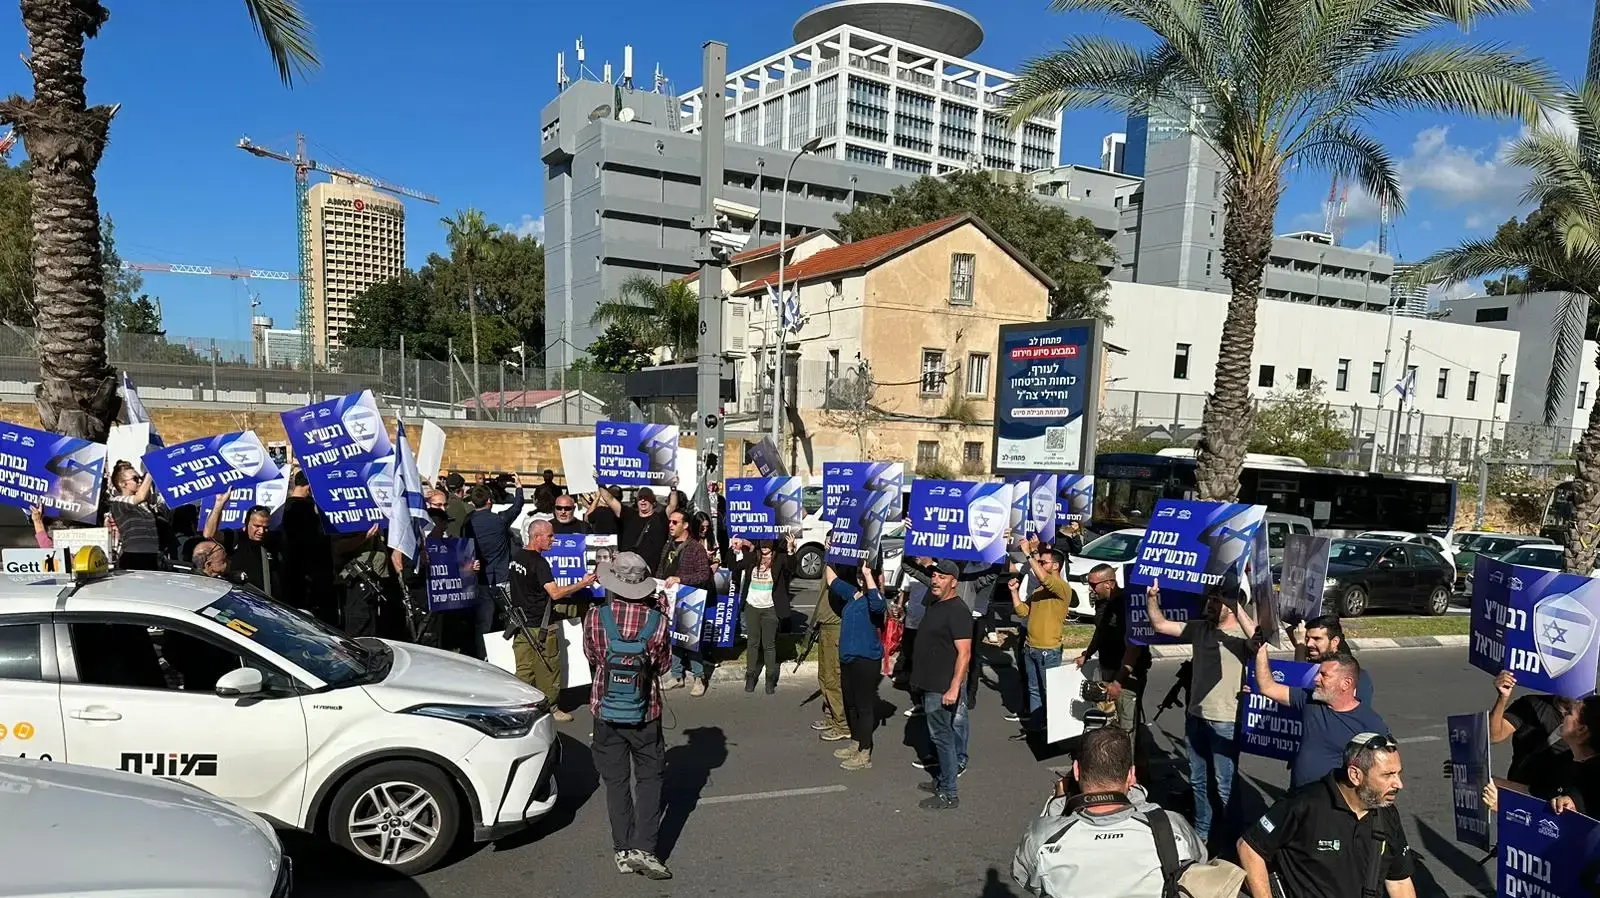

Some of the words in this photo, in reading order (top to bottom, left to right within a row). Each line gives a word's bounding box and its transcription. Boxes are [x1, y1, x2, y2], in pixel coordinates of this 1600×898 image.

[326, 198, 353, 207] AMOT
[1029, 336, 1039, 346] לב
[1040, 336, 1062, 346] פתחון
[1012, 349, 1032, 358] חירום
[1033, 348, 1050, 357] סיוע
[1051, 347, 1076, 356] במבצע
[1028, 362, 1059, 377] לעורף,
[1011, 377, 1047, 389] הביטחון
[1048, 376, 1076, 386] כוחות
[1016, 389, 1039, 400] צה"ל
[1041, 389, 1068, 400] וחיילי
[304, 423, 343, 445] רבש"צ
[302, 447, 340, 468] ישראל
[341, 443, 362, 459] מגן
[600, 444, 624, 456] גבורת
[0, 452, 28, 471] גבורת
[170, 455, 221, 477] רבש"צ
[600, 456, 642, 468] הרבש"צים
[0, 468, 49, 492] הרבש"צים
[218, 469, 244, 485] מגן
[636, 470, 646, 479] של
[167, 474, 216, 499] ישראל
[328, 486, 368, 502] רבש"צ
[230, 488, 253, 501] רבש
[730, 500, 751, 511] גבורת
[325, 509, 365, 524] ישראל
[365, 507, 384, 522] מגן
[730, 512, 768, 523] הרבש"צים
[923, 506, 964, 523] רבש"צ
[911, 530, 950, 547] ישראל
[952, 534, 972, 550] מגן
[1147, 530, 1180, 546] גבורת
[1142, 547, 1198, 567] הרבש"צים
[6, 561, 40, 573] Gett
[1138, 564, 1163, 577] ישראל
[1164, 568, 1185, 581] גיבורי
[1186, 570, 1200, 583] של
[1200, 573, 1226, 586] לזכרם
[1484, 598, 1527, 632] רבש"צ
[1131, 626, 1155, 636] שראל
[1474, 630, 1506, 663] ישראל
[1509, 647, 1540, 674] מגן
[1249, 693, 1279, 712] גבורת
[1247, 712, 1303, 736] הרבש"צים
[1246, 732, 1271, 747] ישראל
[1272, 737, 1293, 752] גיבורי
[1083, 793, 1115, 803] Canon
[1094, 832, 1124, 840] Klim
[1505, 845, 1552, 884] גבורת
